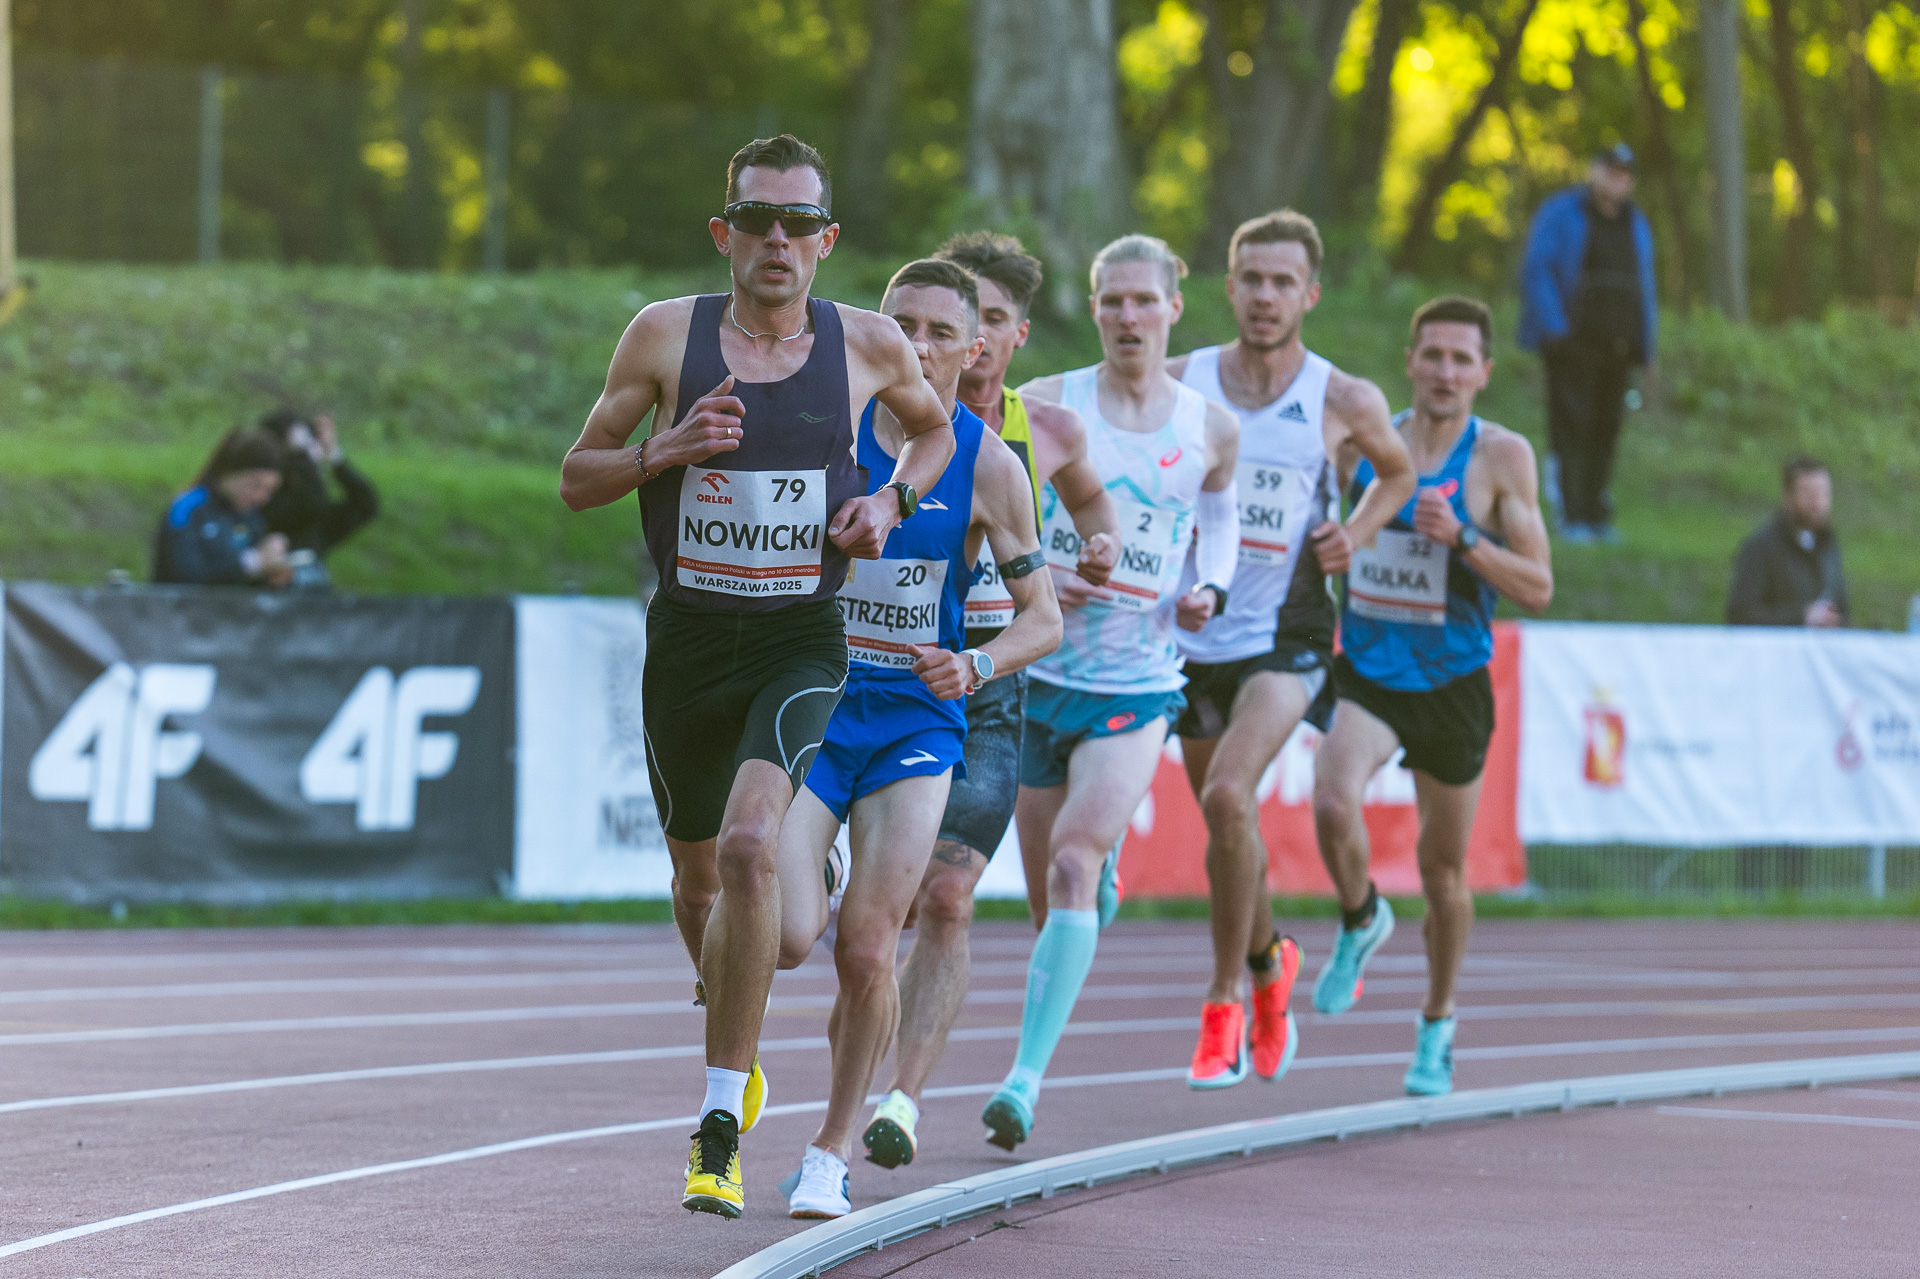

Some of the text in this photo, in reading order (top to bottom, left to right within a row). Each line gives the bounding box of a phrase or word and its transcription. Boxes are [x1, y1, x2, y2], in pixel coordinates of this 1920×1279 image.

[771, 478, 807, 503] 79
[1253, 469, 1282, 491] 59
[696, 493, 733, 505] ORLEN
[1137, 512, 1152, 532] 2
[684, 515, 820, 552] NOWICKI
[694, 575, 803, 593] WARSZAWA 2025
[896, 565, 927, 587] 20
[893, 656, 919, 666] 202
[27, 661, 482, 832] 4F 4F
